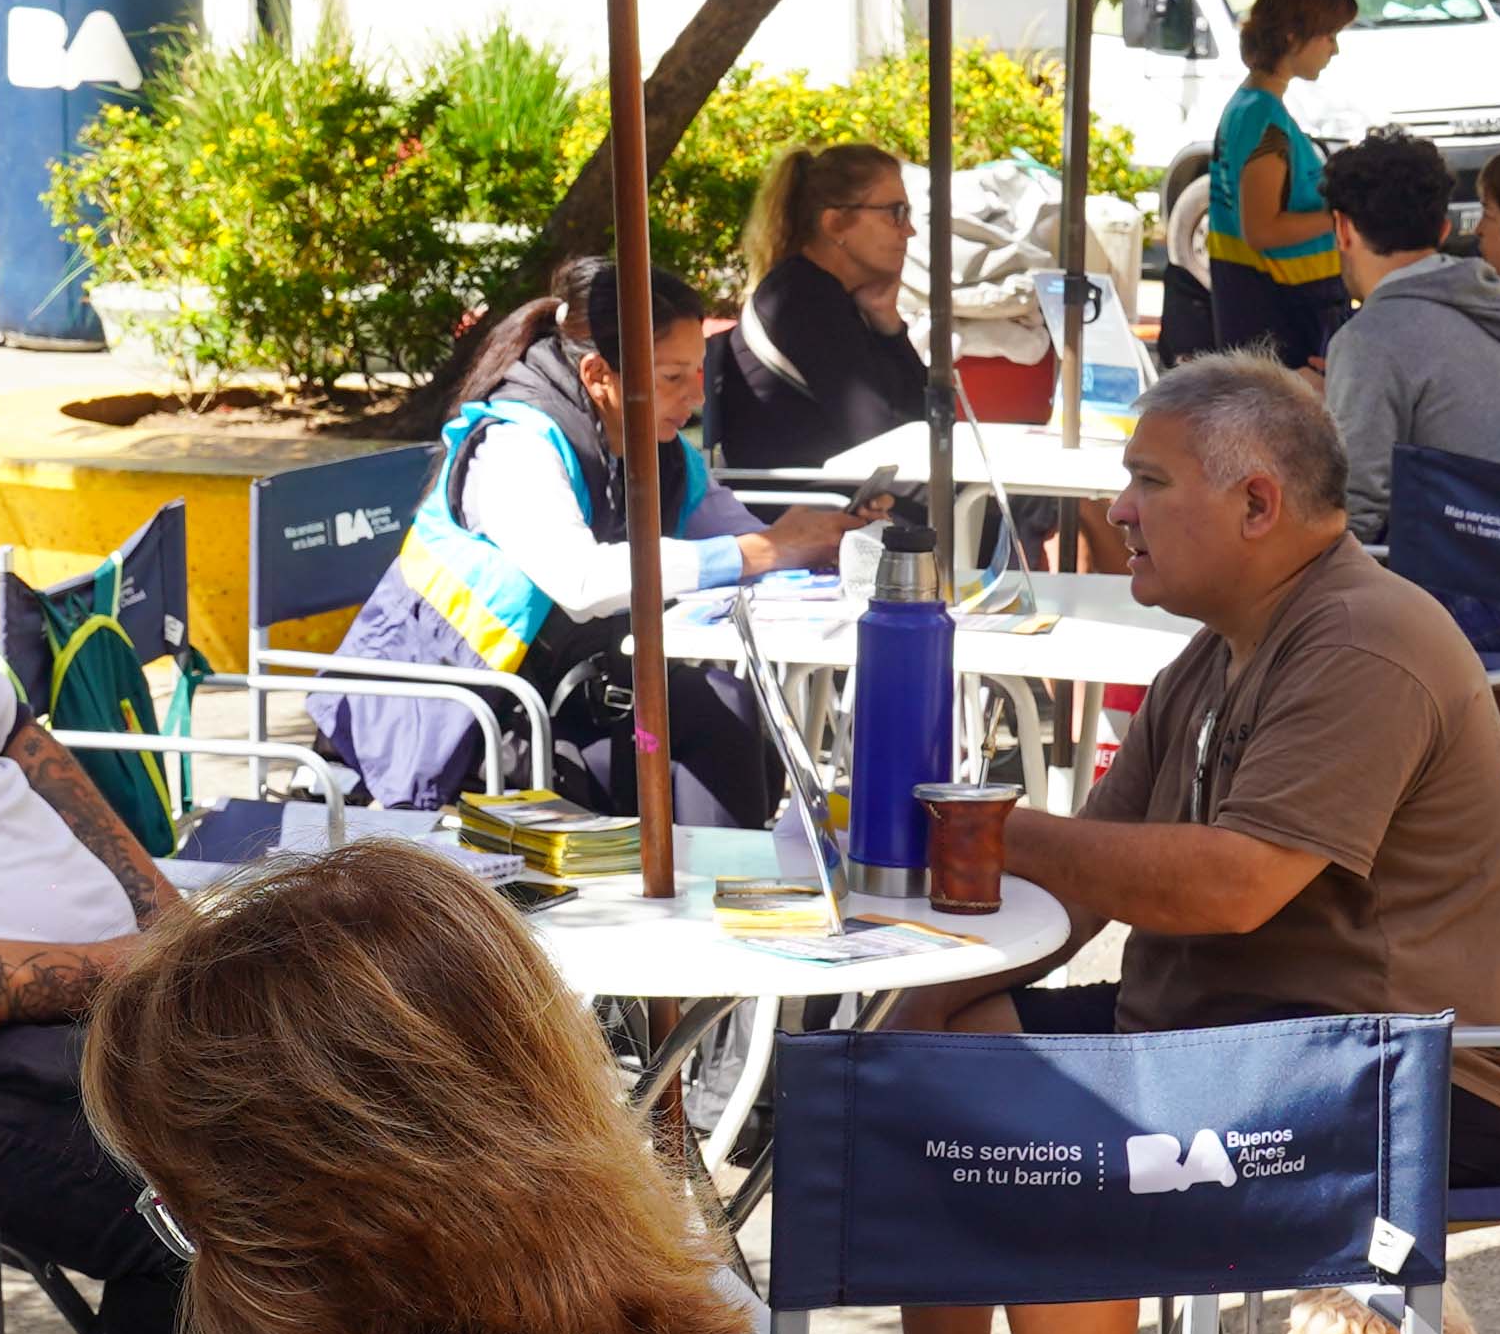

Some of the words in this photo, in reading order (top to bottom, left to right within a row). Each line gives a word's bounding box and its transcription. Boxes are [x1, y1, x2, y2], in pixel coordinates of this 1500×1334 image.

[6, 5, 144, 92] BA
[1226, 1127, 1294, 1148] Buenos
[925, 1139, 975, 1161] Más
[979, 1140, 1083, 1163] servicios
[1125, 1127, 1239, 1195] BA
[1237, 1144, 1287, 1164] Aires
[951, 1169, 985, 1184] en
[985, 1166, 1009, 1185] tu
[1013, 1166, 1083, 1187] barrio
[1241, 1154, 1306, 1180] Ciudad
